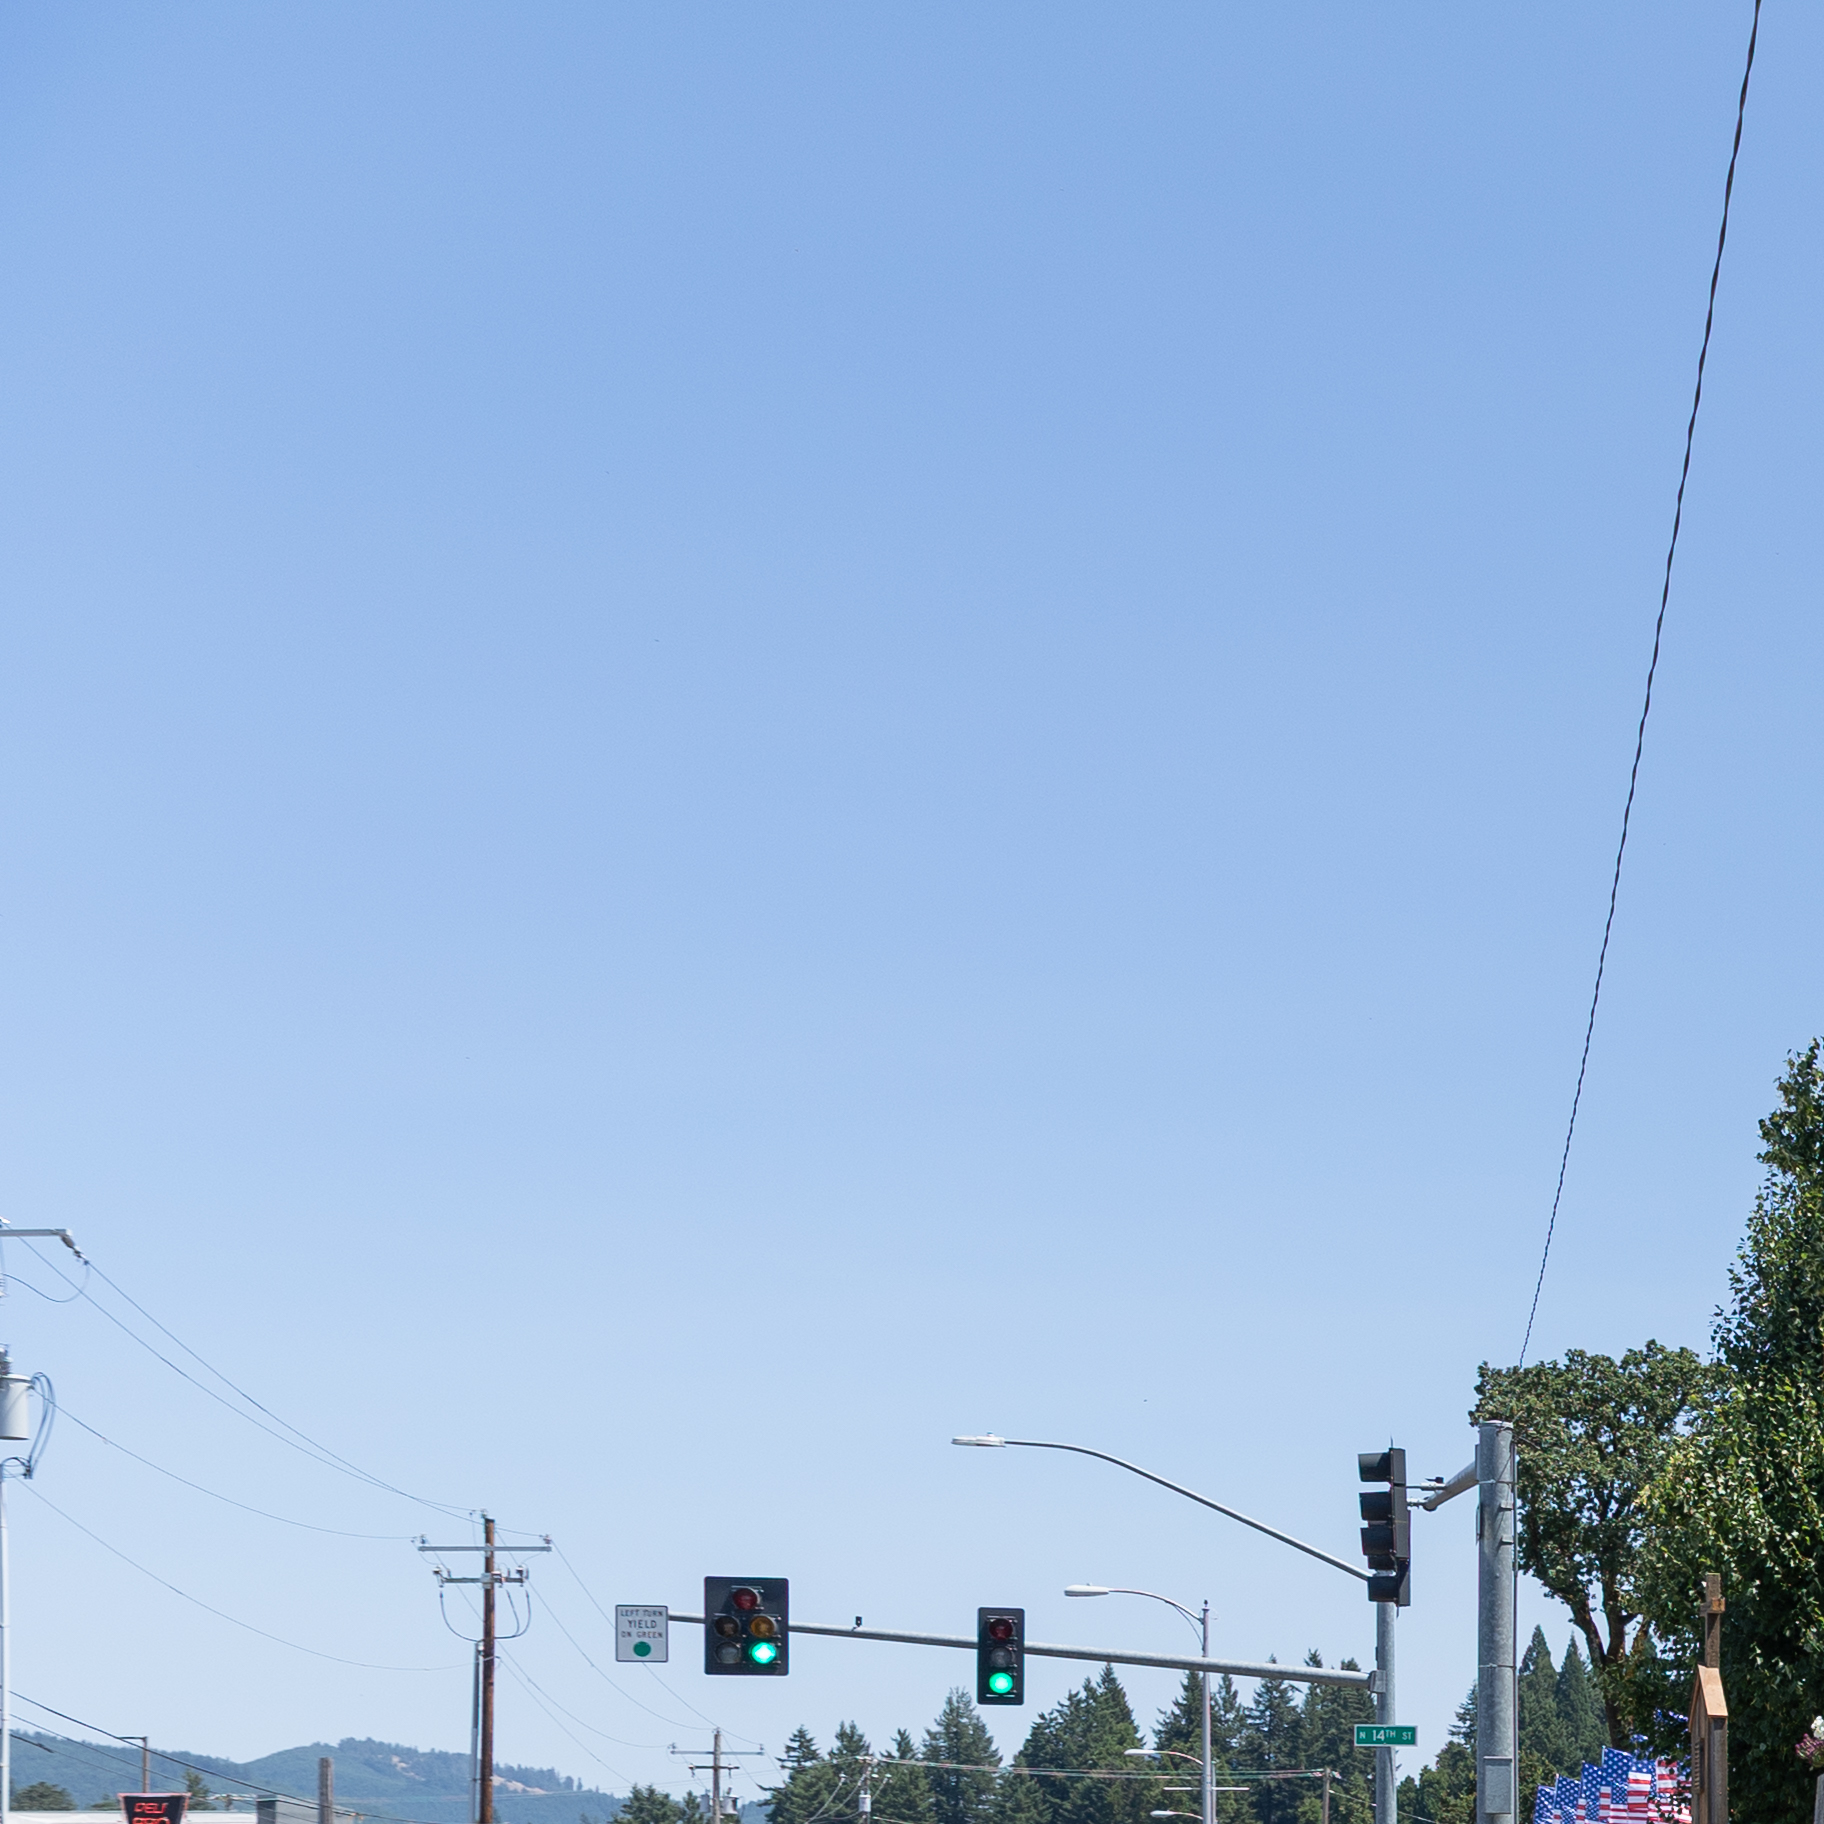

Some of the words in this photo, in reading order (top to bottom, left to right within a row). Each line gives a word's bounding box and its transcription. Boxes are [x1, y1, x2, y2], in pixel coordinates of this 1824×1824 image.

[621, 1609, 639, 1617] LEFT
[627, 1619, 657, 1629] YIELD
[1359, 1731, 1366, 1739] N
[1372, 1729, 1396, 1741] 14TH
[1402, 1731, 1412, 1740] ST
[134, 1802, 169, 1814] DELI
